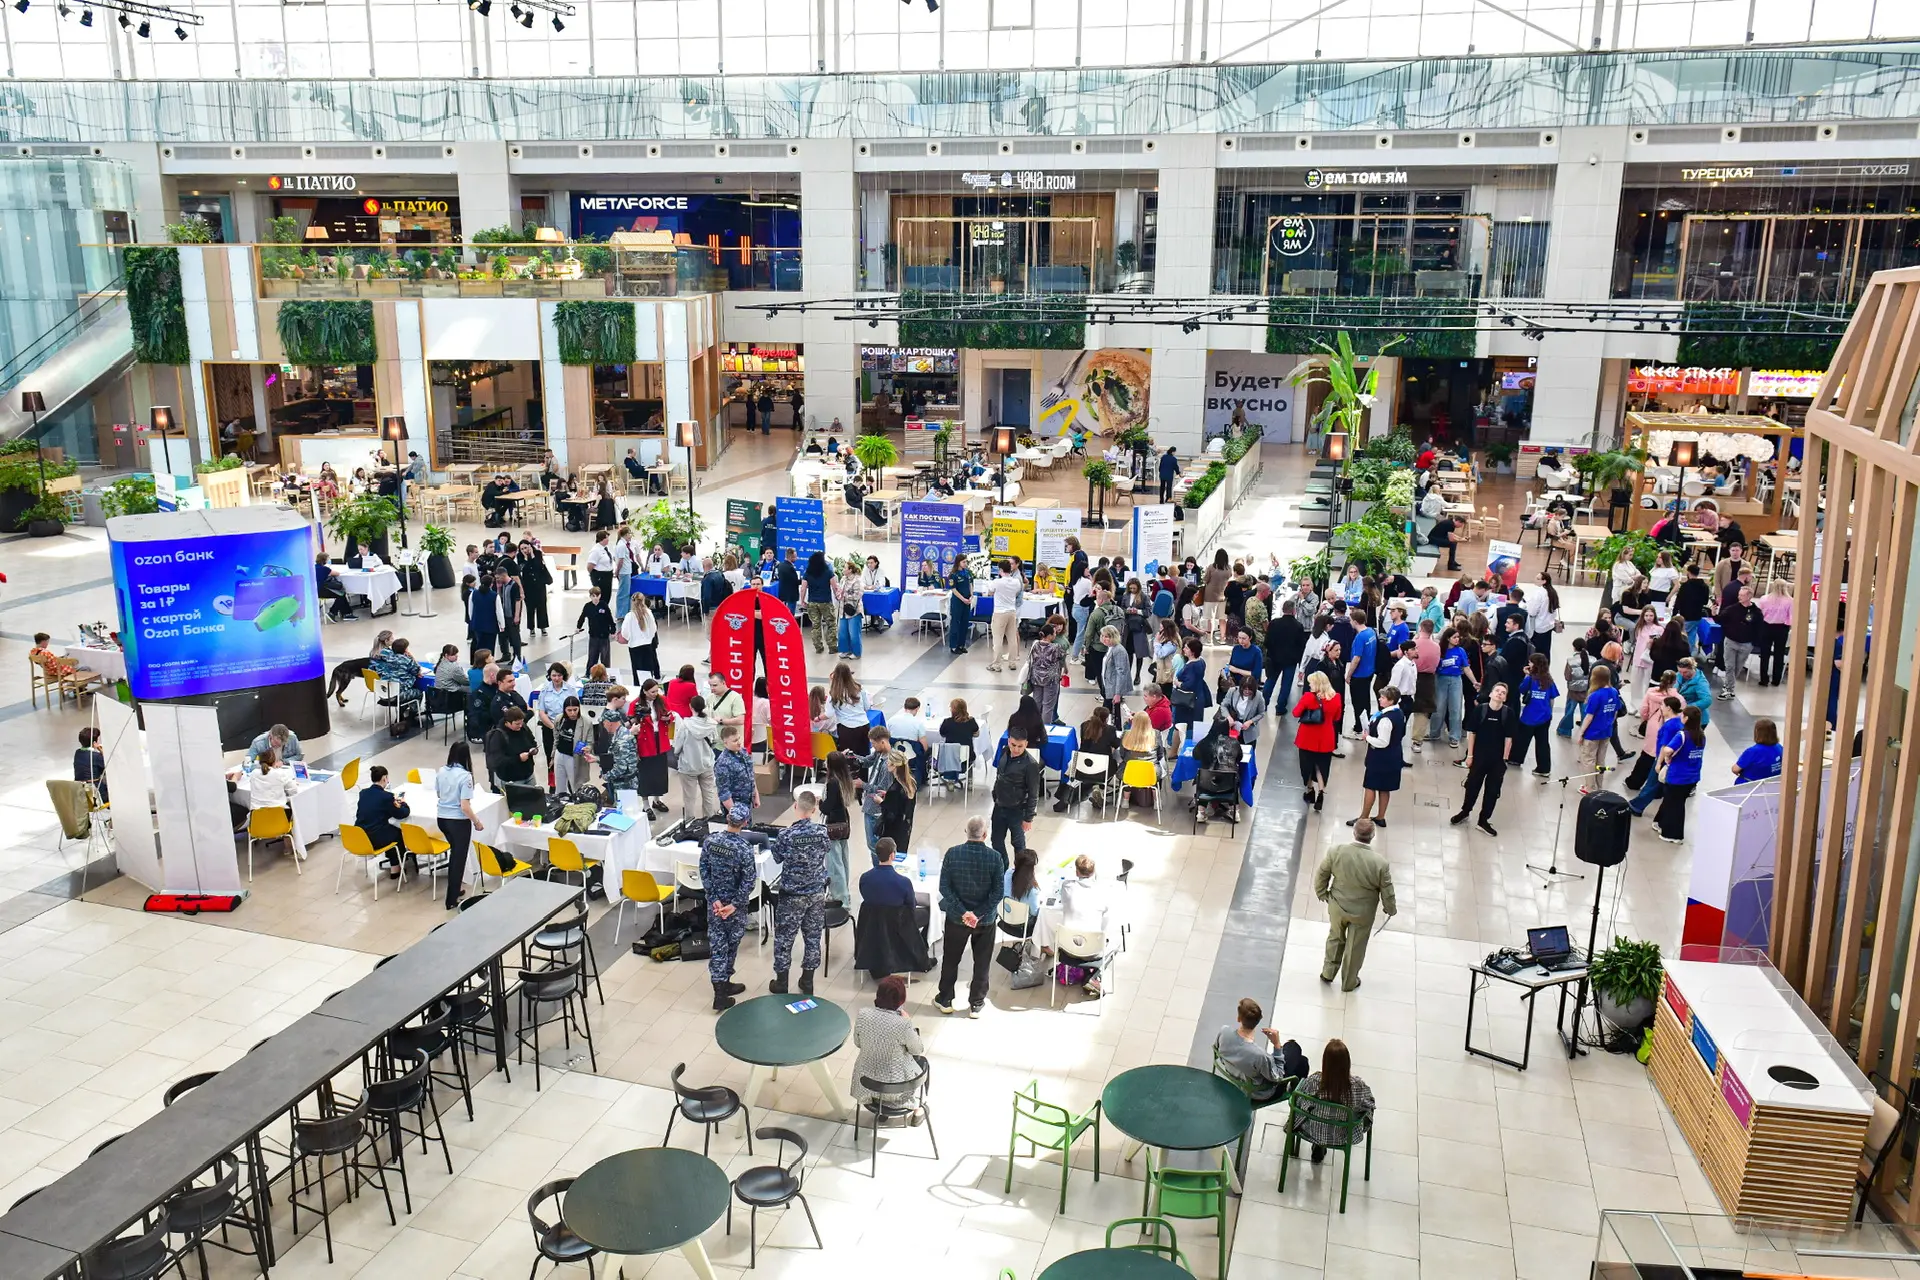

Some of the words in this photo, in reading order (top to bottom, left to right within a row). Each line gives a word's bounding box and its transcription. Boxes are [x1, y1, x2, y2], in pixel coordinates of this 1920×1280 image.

[1682, 167, 1754, 182] ТУРЕЦКАЯ
[1860, 164, 1910, 176] КУХНЯ
[296, 175, 356, 190] ПАТИО
[1047, 175, 1076, 190] ROOM
[394, 200, 448, 213] ПАТИО
[580, 197, 688, 210] METAFORCE
[751, 347, 797, 358] Теремок
[861, 347, 896, 356] РОШКА
[899, 348, 954, 356] КАРТОШКА
[1638, 366, 1681, 379] GREEK
[1684, 367, 1732, 379] STREET
[1214, 370, 1282, 392] Будет
[134, 553, 172, 566] ozon
[175, 550, 215, 562] банк
[138, 582, 191, 595] Товары
[140, 600, 157, 609] за
[142, 616, 150, 624] с
[153, 609, 202, 625] картой
[144, 626, 180, 640] Ozon
[183, 624, 226, 636] Банка
[777, 642, 797, 759] SUNLIGHT
